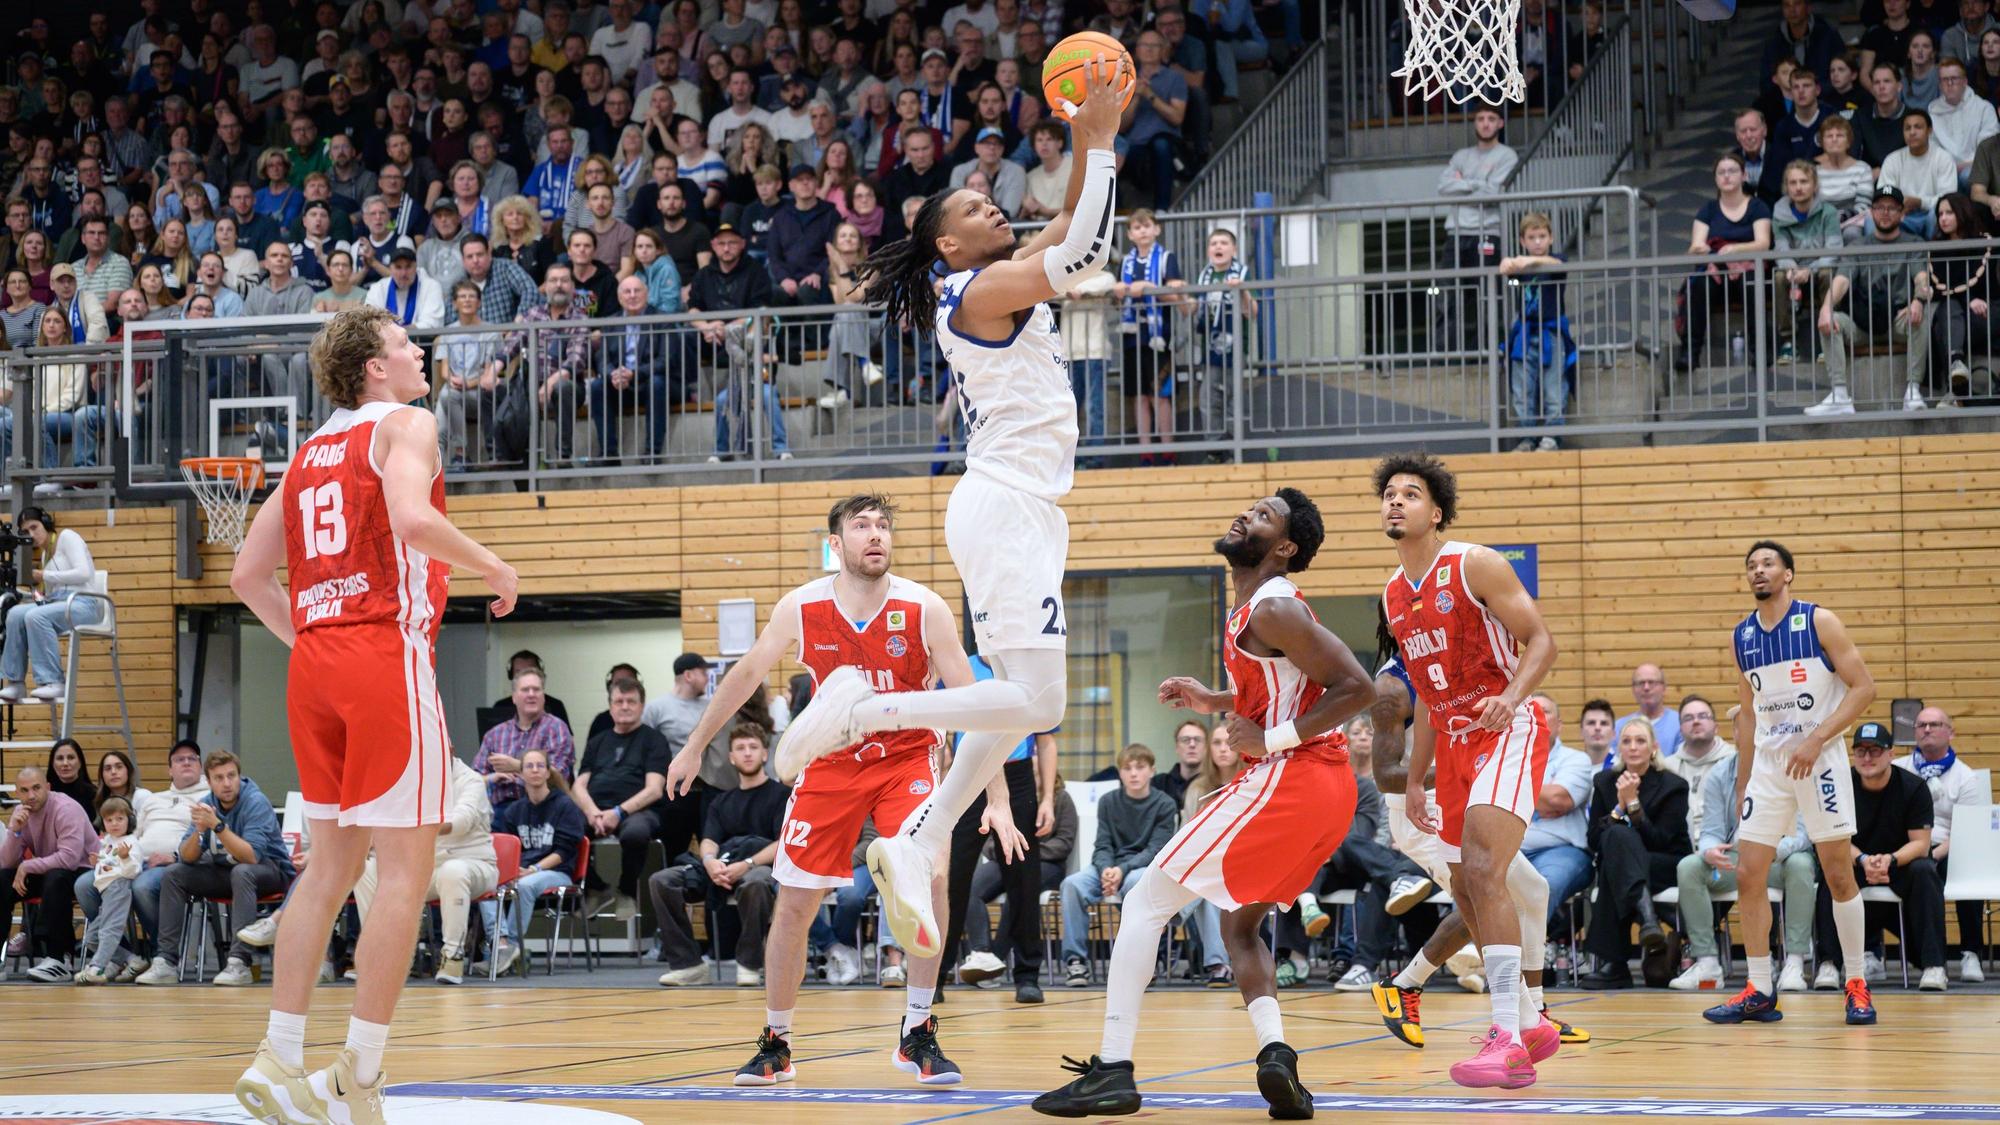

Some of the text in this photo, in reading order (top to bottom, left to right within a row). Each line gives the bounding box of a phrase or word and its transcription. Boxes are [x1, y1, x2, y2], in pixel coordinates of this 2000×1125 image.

[298, 481, 347, 560] 13
[1041, 596, 1066, 635] 2
[814, 643, 839, 651] SPALDING
[1402, 626, 1448, 661] KÖLN
[1427, 663, 1449, 691] 9
[1457, 684, 1488, 704] Storch
[1819, 767, 1839, 814] VBW
[785, 819, 812, 848] 12
[739, 1092, 935, 1100] Elektro
